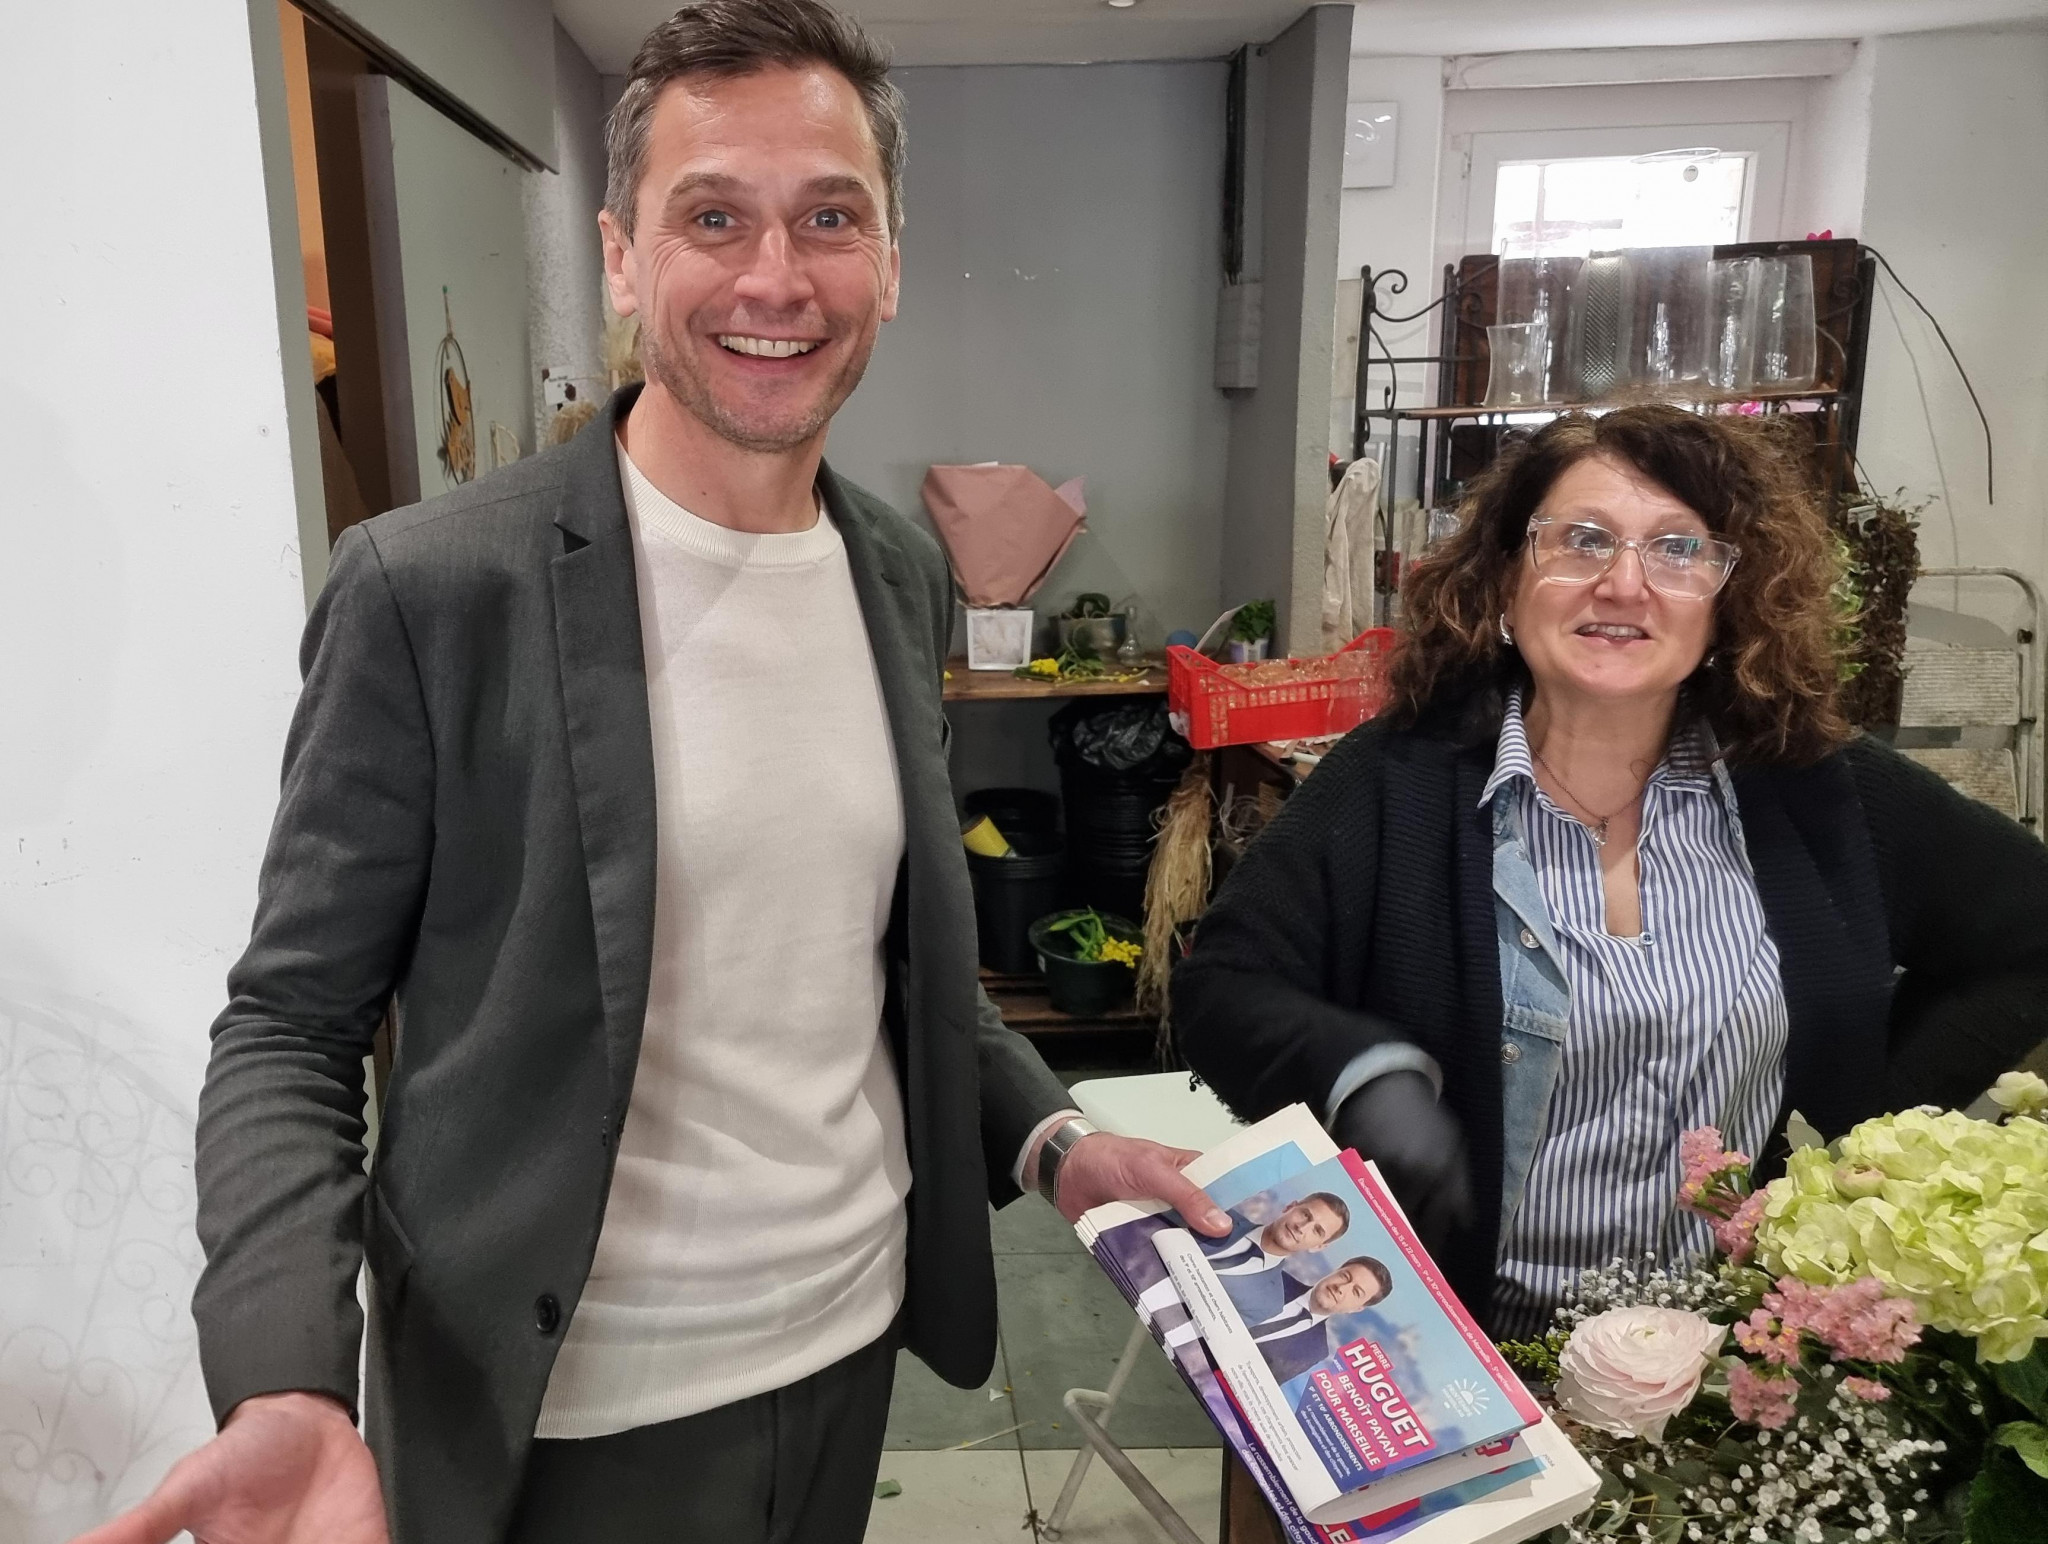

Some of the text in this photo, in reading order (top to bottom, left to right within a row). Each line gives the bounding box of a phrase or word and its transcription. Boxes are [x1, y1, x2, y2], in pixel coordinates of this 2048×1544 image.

[1391, 1226, 1399, 1236] des
[1405, 1246, 1413, 1254] 22
[1410, 1252, 1421, 1268] mars
[1472, 1339, 1491, 1363] Marseille
[1333, 1358, 1343, 1372] AVEC
[1345, 1344, 1429, 1448] HUGUET
[1370, 1343, 1390, 1370] PIERRE
[1310, 1410, 1334, 1446] rassemblement
[1312, 1393, 1321, 1401] ET
[1323, 1414, 1363, 1471] ARRONDISSEMENTS
[1316, 1372, 1380, 1467] POUR MARSEILLE
[1338, 1374, 1399, 1459] BENOÎT PAYAN
[1242, 1449, 1252, 1463] des
[1247, 1459, 1277, 1503] écologistes
[1273, 1502, 1284, 1512] et
[1279, 1511, 1292, 1526] des
[1247, 1442, 1256, 1452] Le
[1254, 1452, 1293, 1505] rassemblement
[1289, 1506, 1298, 1516] de
[1296, 1516, 1303, 1524] la
